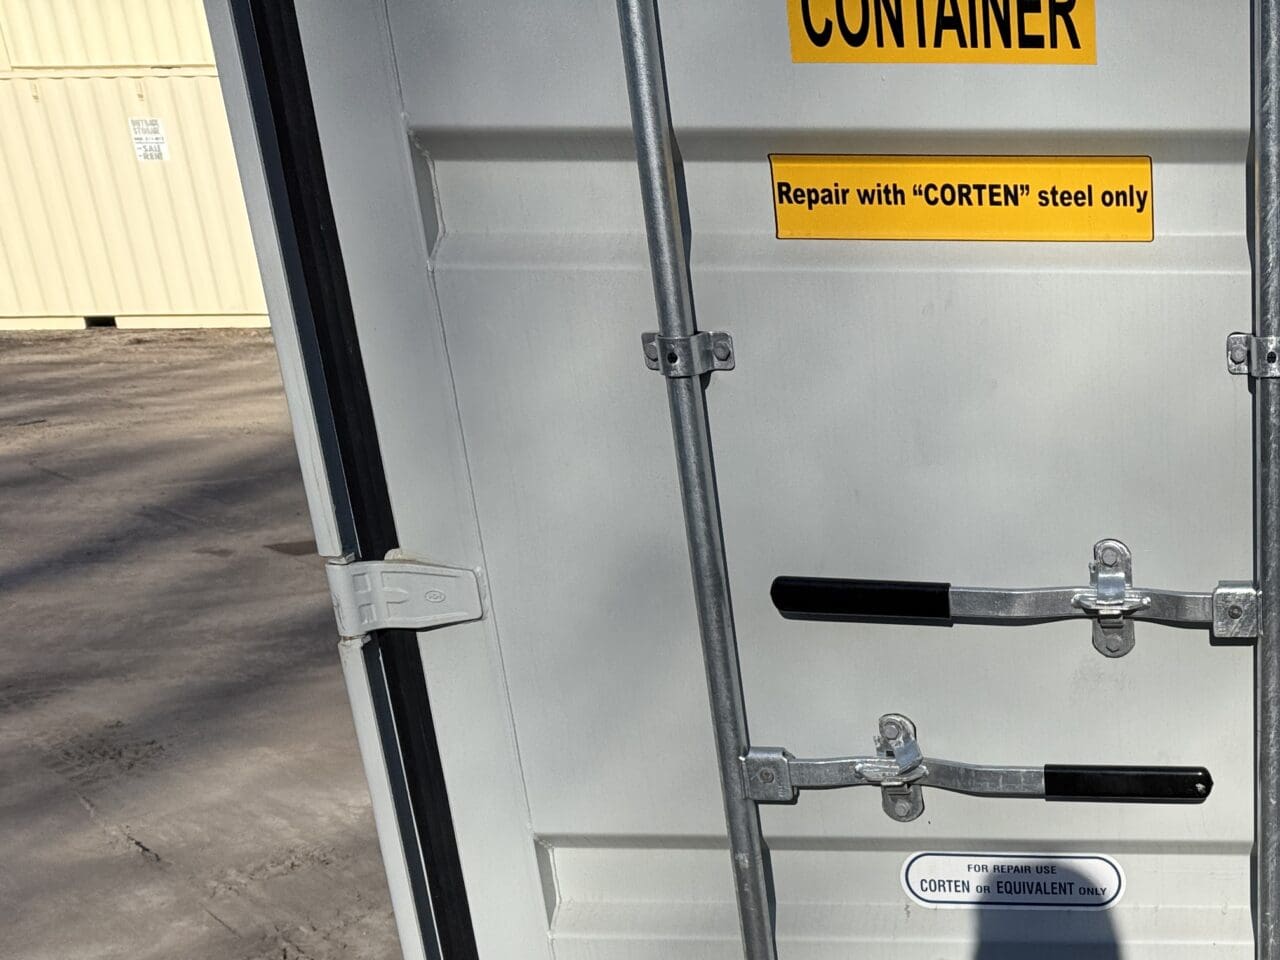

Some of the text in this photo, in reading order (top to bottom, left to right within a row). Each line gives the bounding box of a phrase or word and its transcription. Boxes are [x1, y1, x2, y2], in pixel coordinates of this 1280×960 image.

[777, 181, 850, 210] Repair
[856, 183, 906, 207] with
[1038, 185, 1093, 208] steel
[1101, 185, 1148, 213] only
[967, 864, 1057, 875] FOR REPAIR USE
[920, 878, 1107, 896] CORTEN OR EQUIVALENT ONLY
